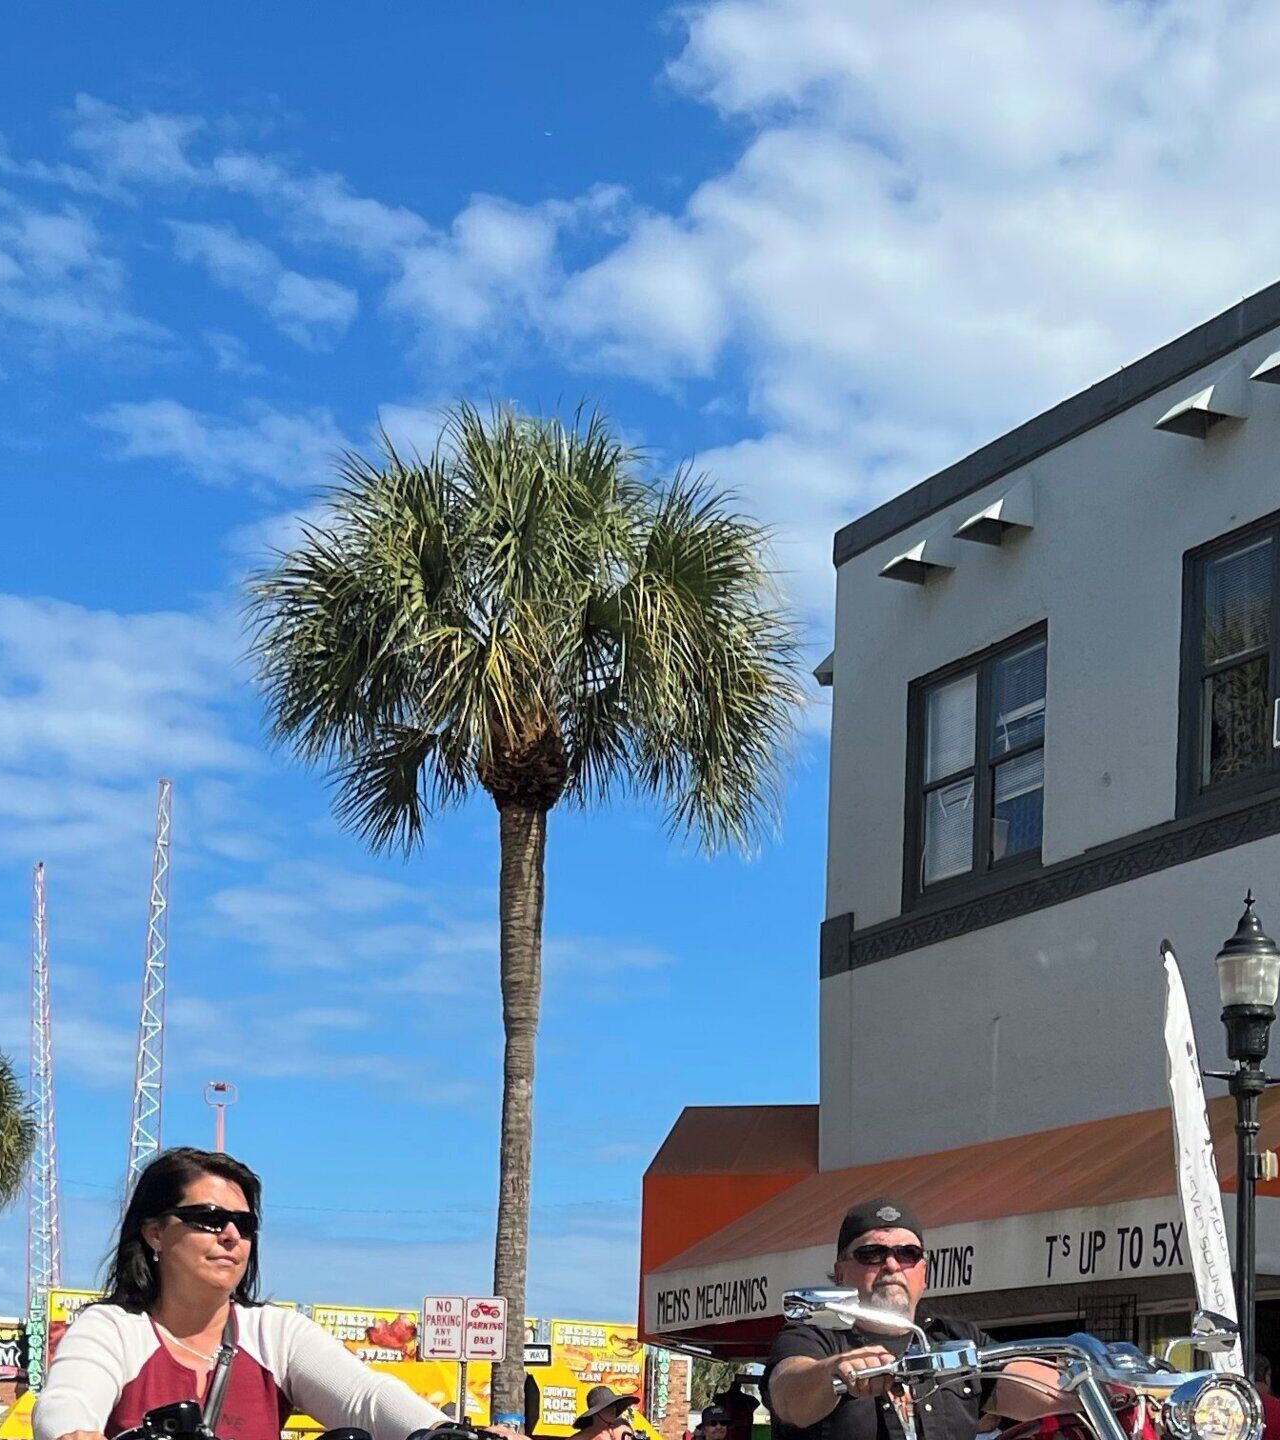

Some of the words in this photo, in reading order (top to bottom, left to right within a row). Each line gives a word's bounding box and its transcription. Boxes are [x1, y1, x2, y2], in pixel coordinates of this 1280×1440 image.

[1079, 1230, 1106, 1275] UP
[1118, 1226, 1144, 1272] TO
[1153, 1221, 1184, 1268] 5X
[695, 1276, 768, 1320] MECHANICS
[435, 1300, 452, 1312] NO
[426, 1314, 461, 1328] PARKING
[467, 1321, 504, 1331] PARKING
[435, 1328, 451, 1336] ANY
[433, 1337, 452, 1347] TIME
[473, 1335, 495, 1345] ONLY
[556, 1336, 607, 1348] BURGER
[529, 1351, 547, 1361] WAY
[590, 1361, 612, 1372] HOT
[613, 1363, 640, 1374] DOGS
[543, 1398, 577, 1411] ROCK
[543, 1411, 578, 1424] INSIDE
